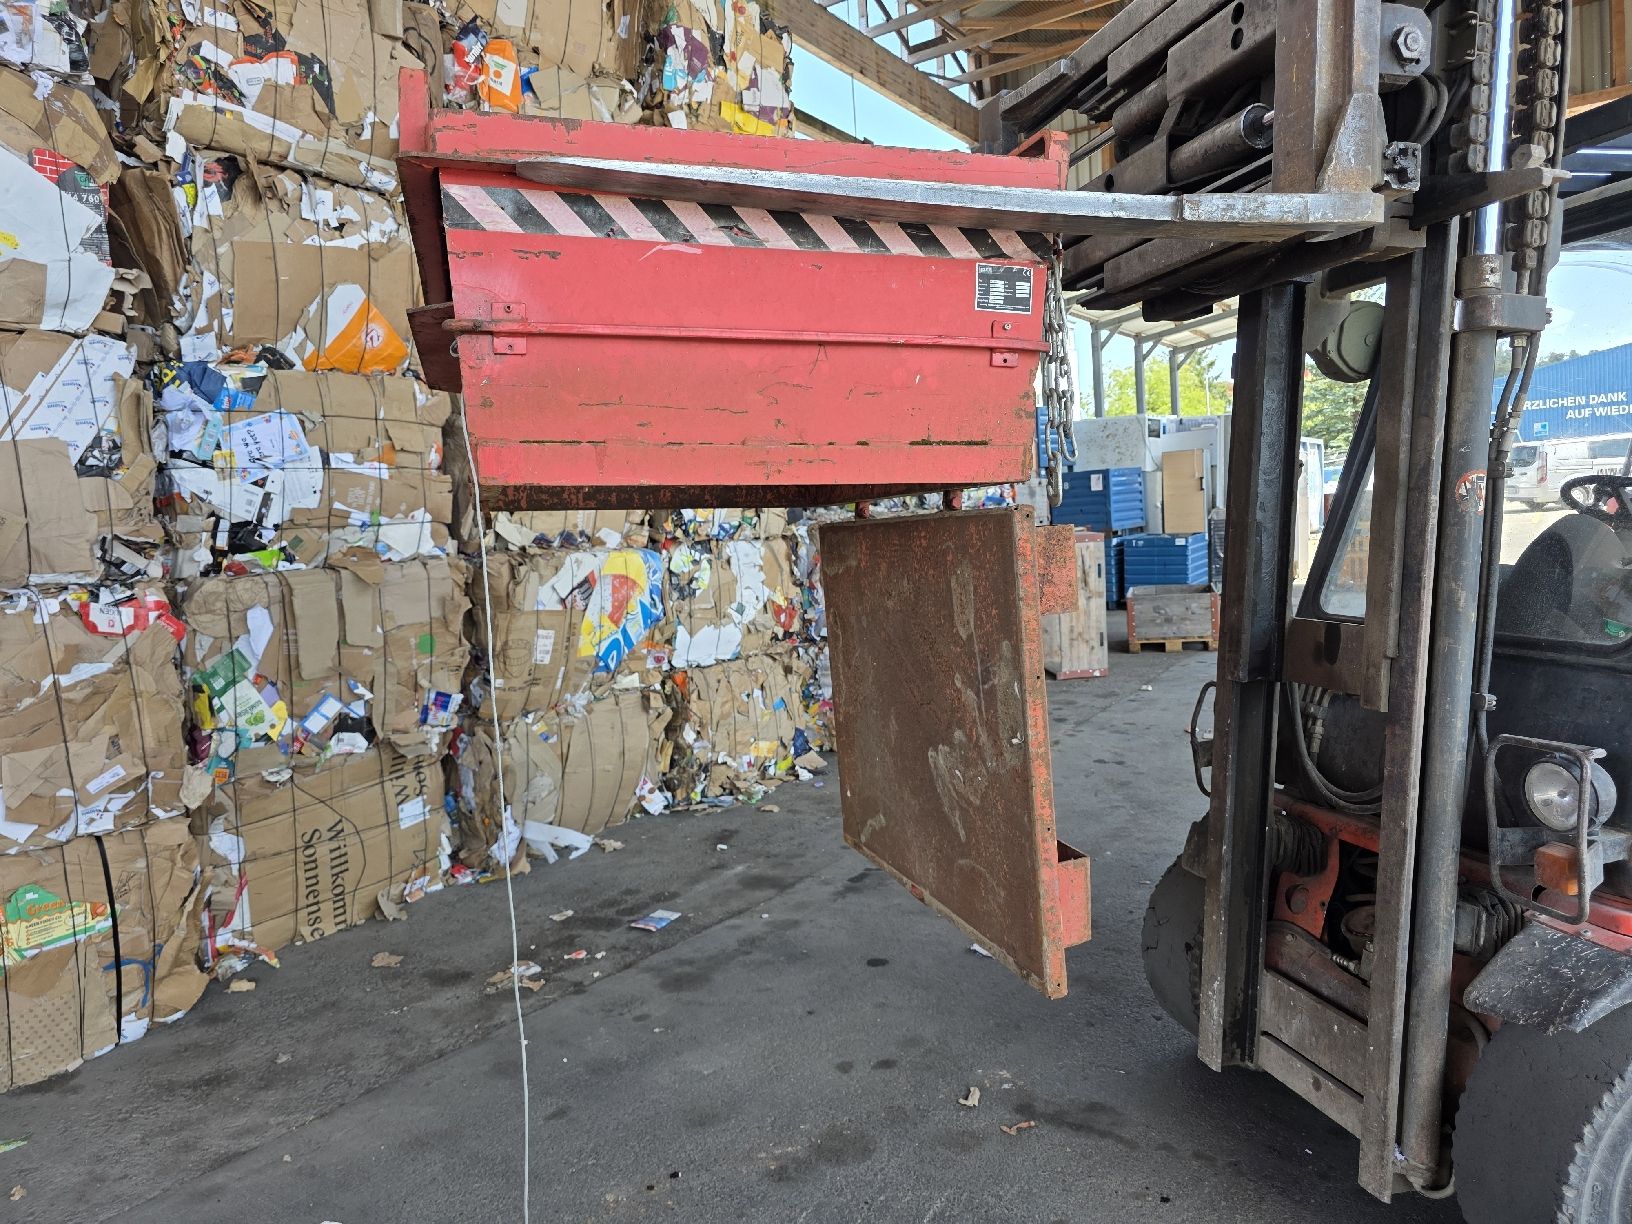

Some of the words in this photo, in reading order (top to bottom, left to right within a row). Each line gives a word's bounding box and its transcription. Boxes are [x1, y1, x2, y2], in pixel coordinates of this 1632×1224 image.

[1523, 396, 1586, 412] RZLICHEN
[1589, 391, 1628, 405] DANK
[1565, 408, 1593, 420] AUF
[301, 828, 325, 940] Sonnense
